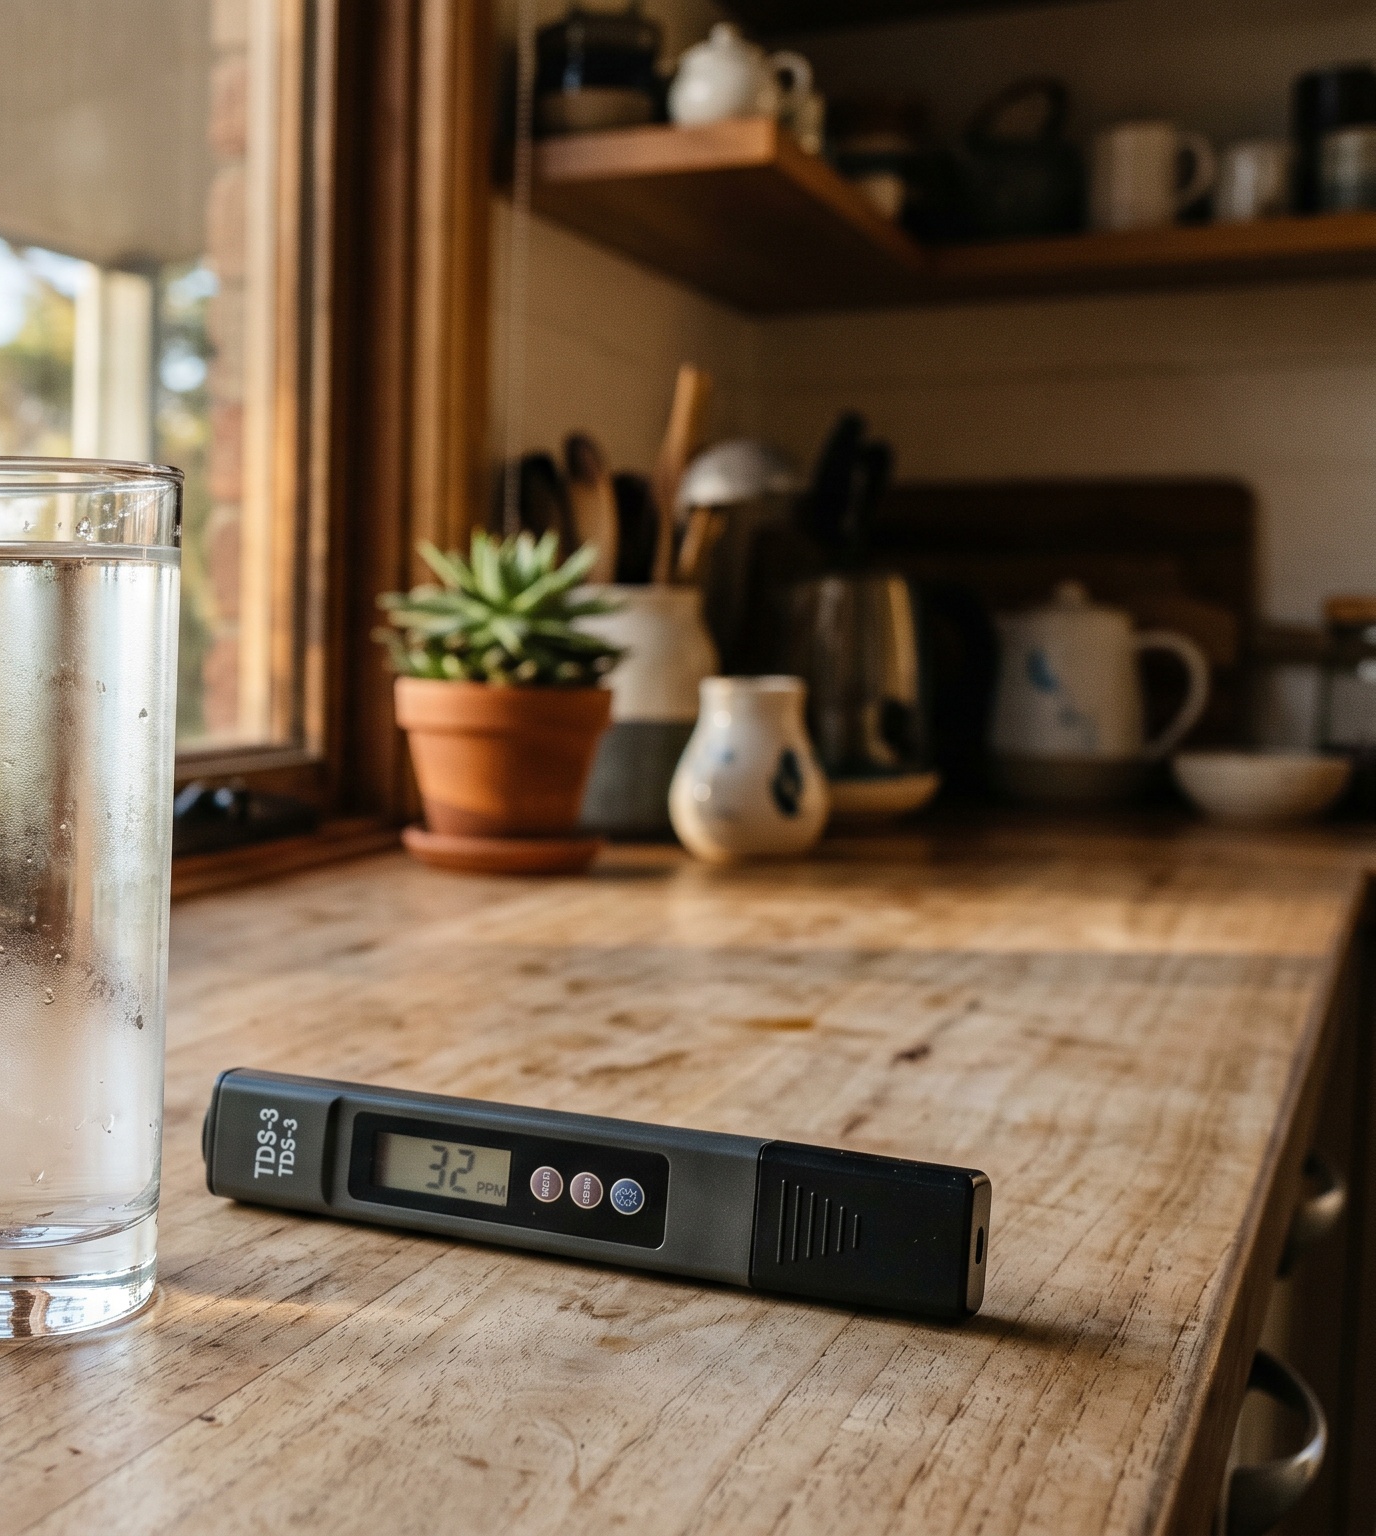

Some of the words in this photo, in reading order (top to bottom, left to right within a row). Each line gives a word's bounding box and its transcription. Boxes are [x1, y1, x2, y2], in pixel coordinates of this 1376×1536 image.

[254, 1108, 279, 1179] TDS-3
[278, 1118, 298, 1177] TDS-3
[425, 1144, 475, 1193] 32
[476, 1181, 506, 1198] PPM
